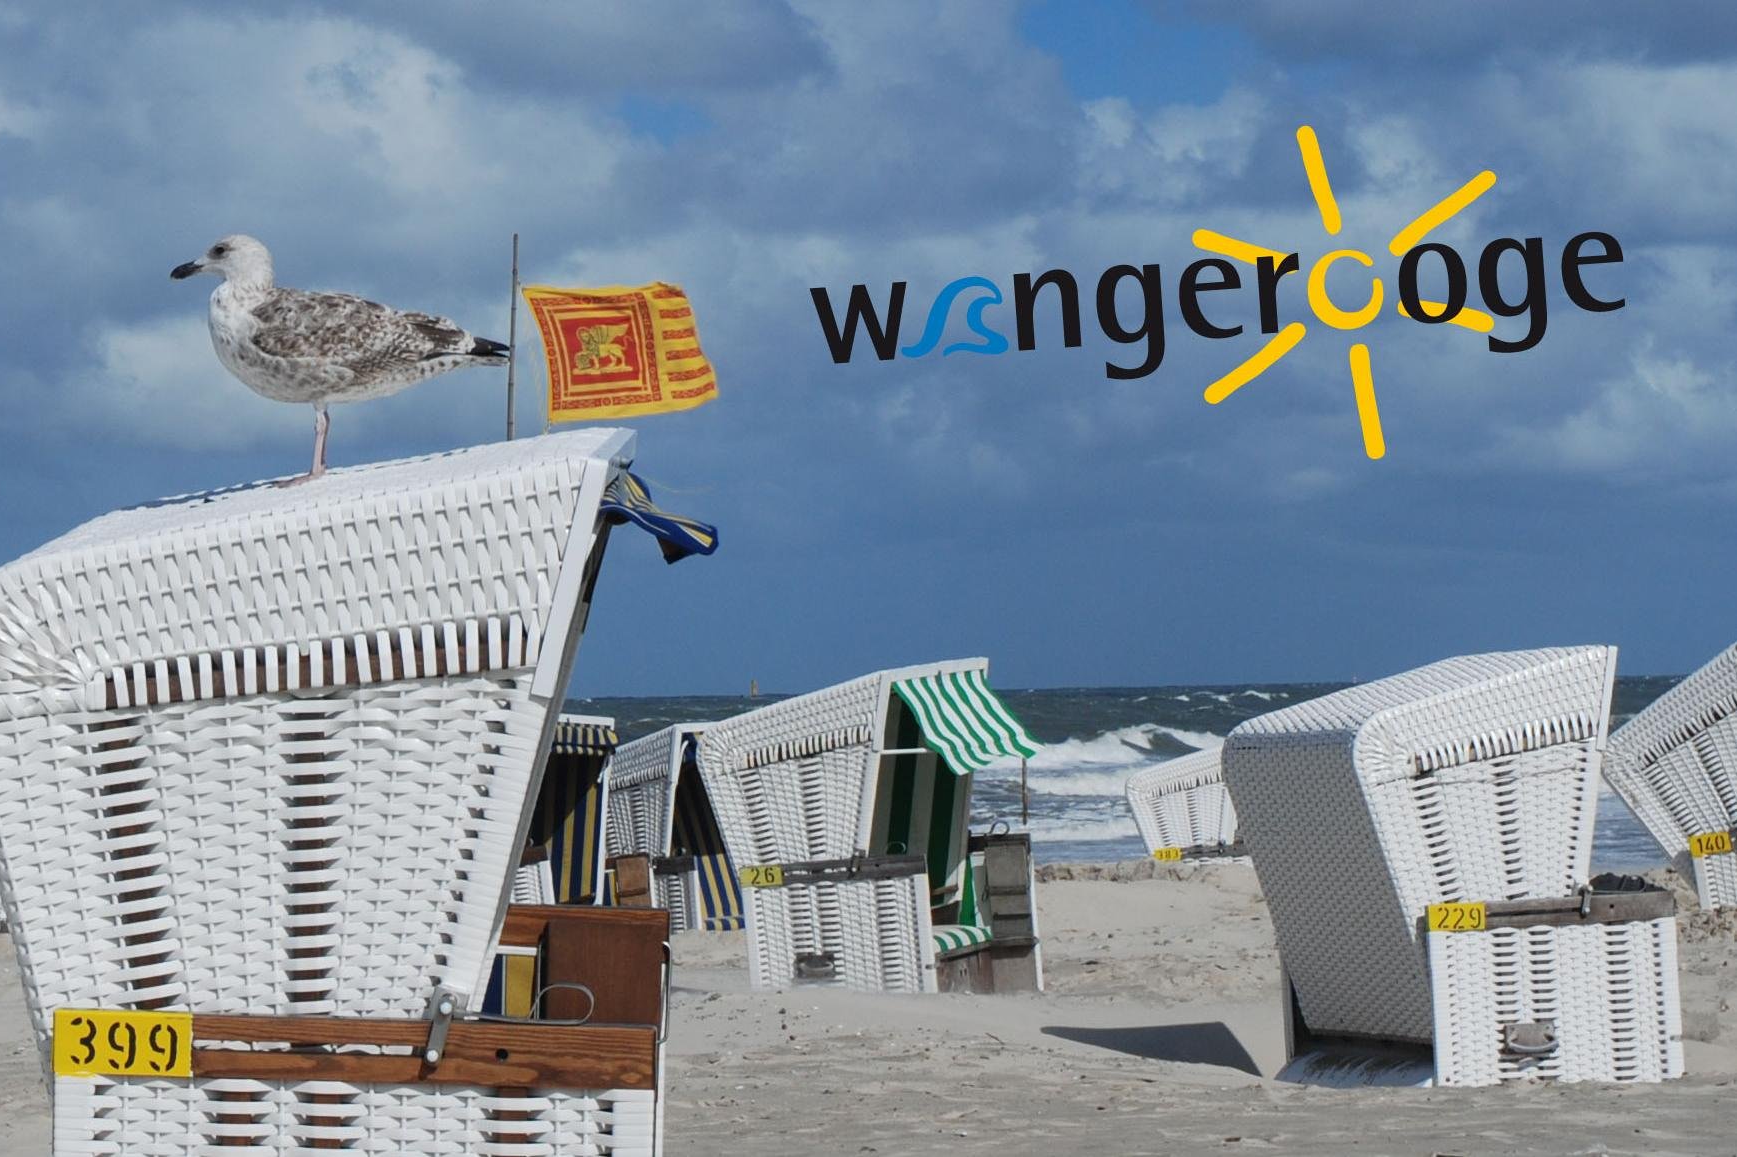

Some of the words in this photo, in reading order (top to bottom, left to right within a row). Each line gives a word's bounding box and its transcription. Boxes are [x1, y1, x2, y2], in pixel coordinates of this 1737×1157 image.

[1696, 835, 1725, 853] 140
[751, 867, 775, 884] 26
[1437, 907, 1481, 929] 229
[69, 1016, 179, 1072] 399
